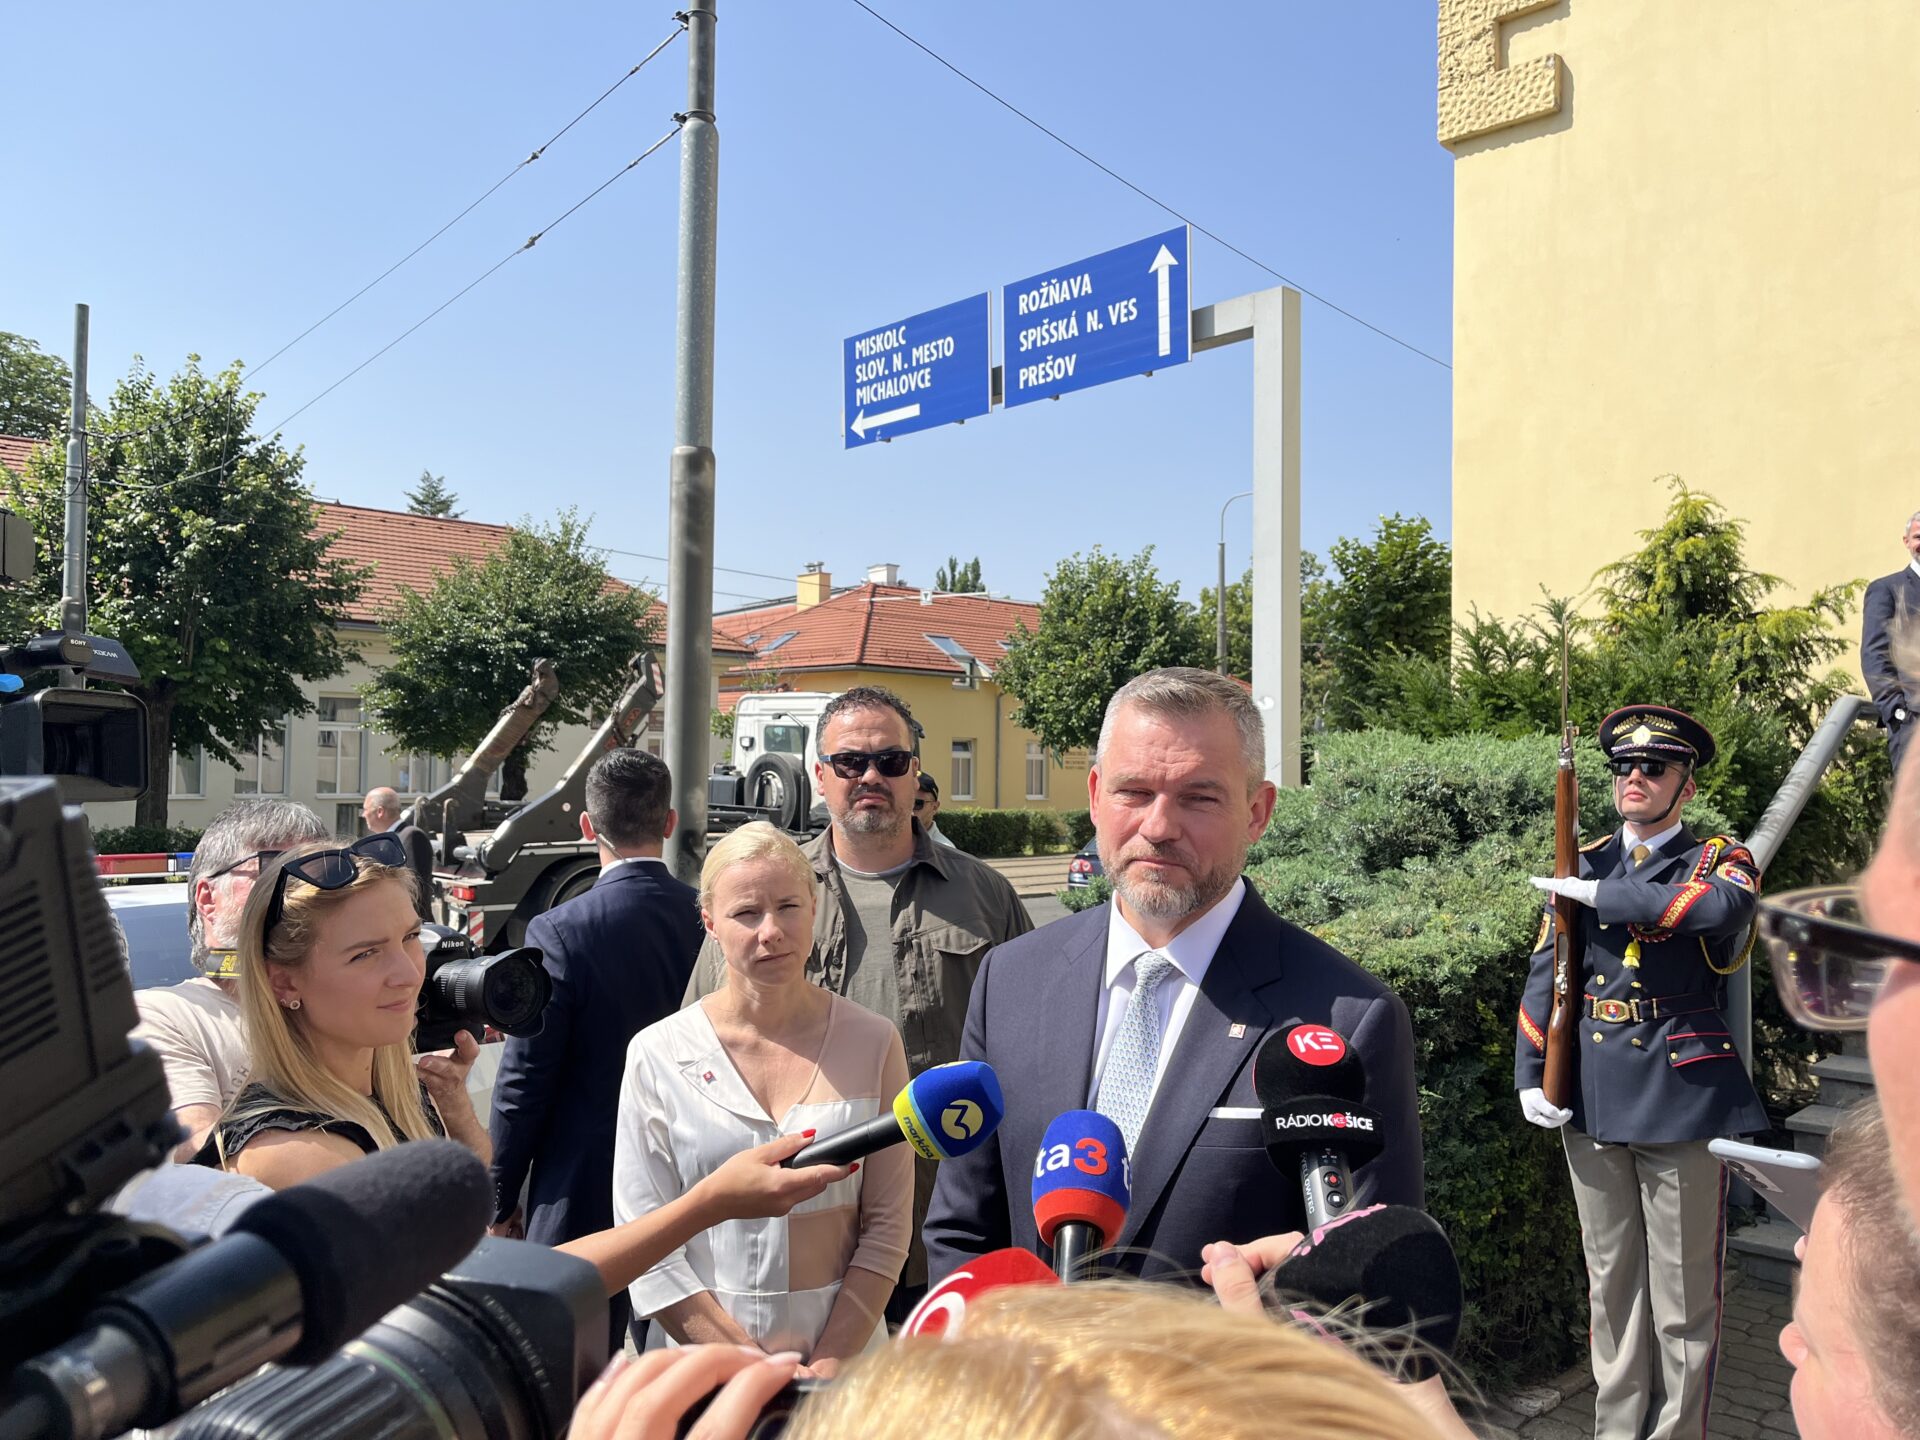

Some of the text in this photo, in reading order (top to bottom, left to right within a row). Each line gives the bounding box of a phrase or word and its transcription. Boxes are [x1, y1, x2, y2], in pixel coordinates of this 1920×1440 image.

[1018, 273, 1092, 316] ROŽŇAVA
[855, 325, 907, 359] MISKOLC
[1019, 297, 1138, 352] SPIŠSKÁ N. VES
[855, 336, 954, 383] SLOV. N. MESTO
[1019, 353, 1077, 390] PREŠOV
[856, 368, 931, 407] MICHALOVCE
[441, 941, 465, 949] Nikon
[1294, 1031, 1339, 1053] KE
[1275, 1113, 1322, 1130] RÁDIO
[1035, 1137, 1108, 1179] ta3
